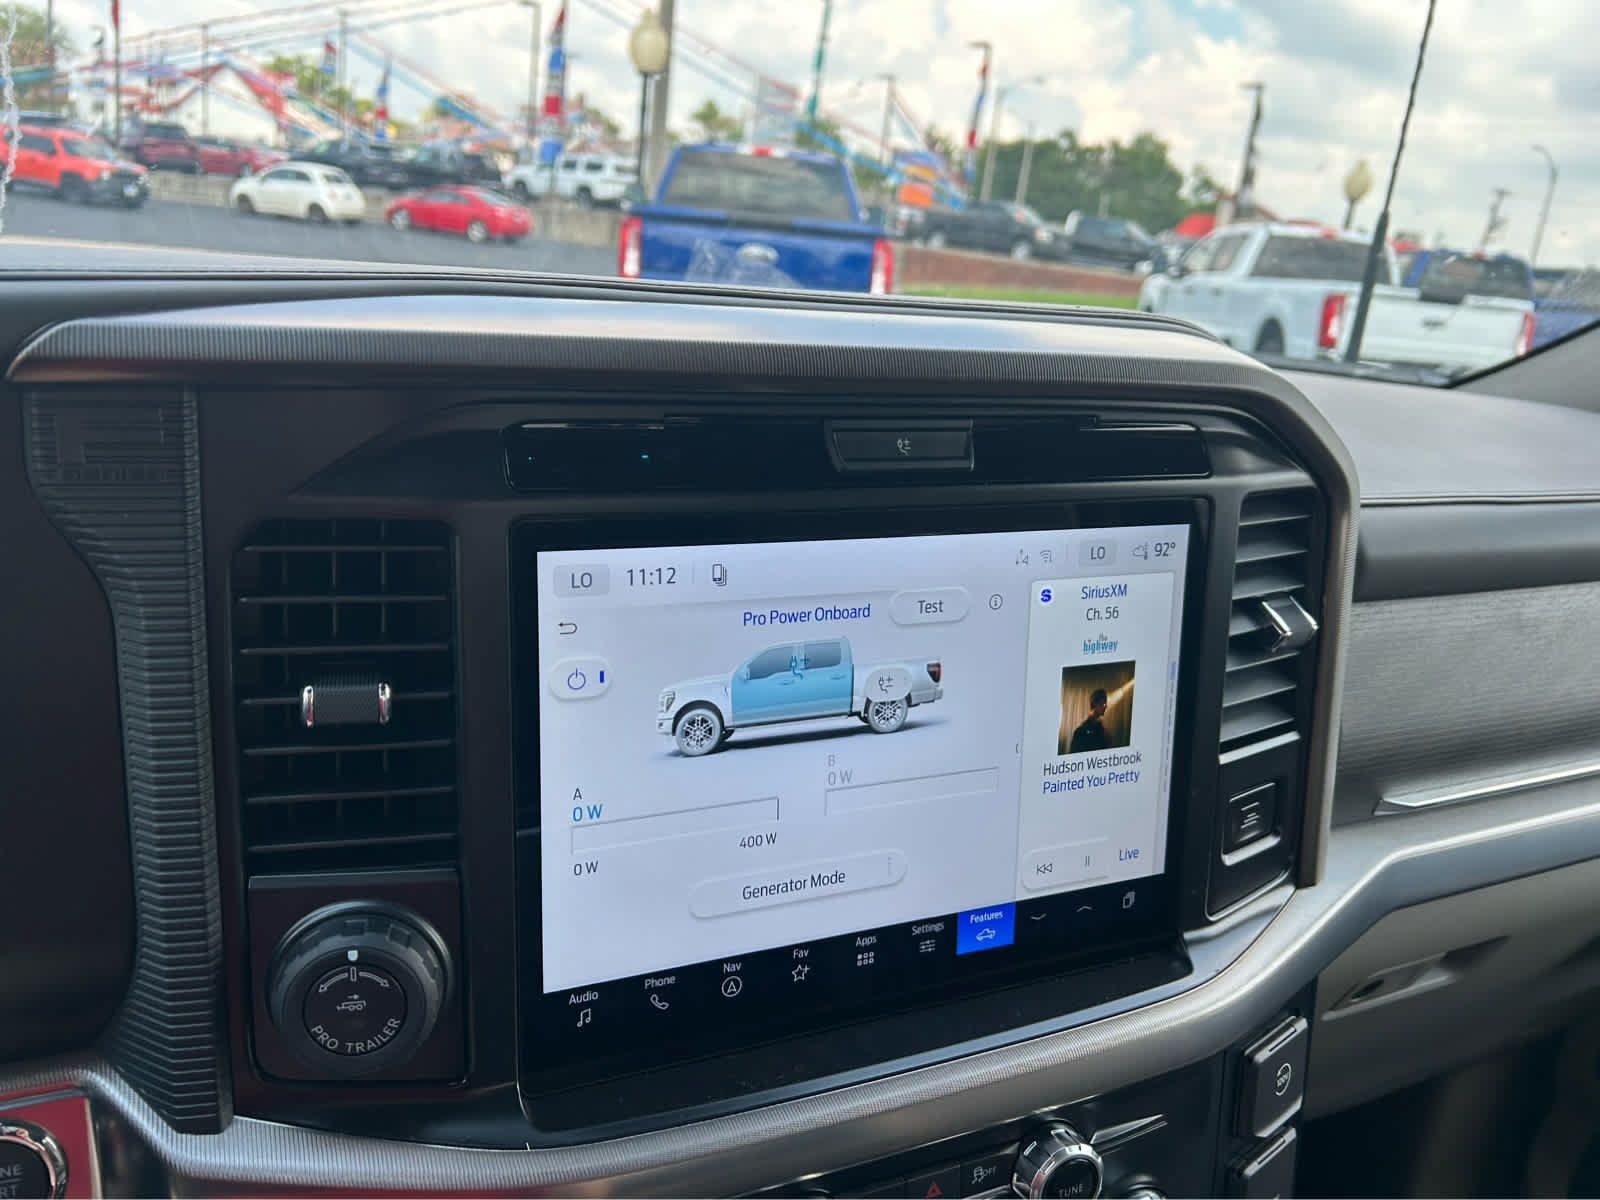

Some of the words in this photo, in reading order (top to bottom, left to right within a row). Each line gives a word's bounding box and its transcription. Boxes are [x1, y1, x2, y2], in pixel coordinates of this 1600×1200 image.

[1090, 546, 1106, 560] LO
[1154, 542, 1176, 557] 92°
[571, 572, 593, 589] LO
[627, 567, 677, 587] 11:12
[1081, 583, 1128, 599] SiriusXM
[918, 599, 944, 614] Test
[1086, 607, 1103, 621] Ch.
[1105, 606, 1119, 620] 56
[743, 611, 766, 626] Pro
[769, 608, 812, 624] Power
[814, 603, 871, 621] Onboard
[1083, 639, 1118, 655] highway
[1043, 759, 1084, 776] Hudson
[1086, 751, 1142, 770] Westbrook
[839, 770, 853, 784] W
[1042, 777, 1084, 794] Painted
[1087, 773, 1106, 787] You
[1108, 769, 1141, 786] Pretty
[573, 787, 582, 800] A
[572, 806, 583, 822] 0
[587, 803, 603, 819] W
[739, 834, 763, 849] 400
[765, 832, 777, 845] W
[1119, 847, 1140, 861] Live
[585, 860, 599, 874] W
[742, 879, 808, 900] Generator
[810, 870, 846, 888] Mode
[969, 909, 1003, 924] Features
[911, 920, 945, 936] Settings
[855, 934, 877, 947] Apps
[793, 947, 809, 960] Fav
[723, 961, 742, 974] Nav
[644, 974, 676, 989] Phone
[568, 990, 599, 1005] Audio
[311, 1024, 338, 1049] PRO
[345, 1018, 400, 1053] TRAILER
[983, 1166, 997, 1177] OFF
[1058, 1184, 1084, 1197] TUNE
